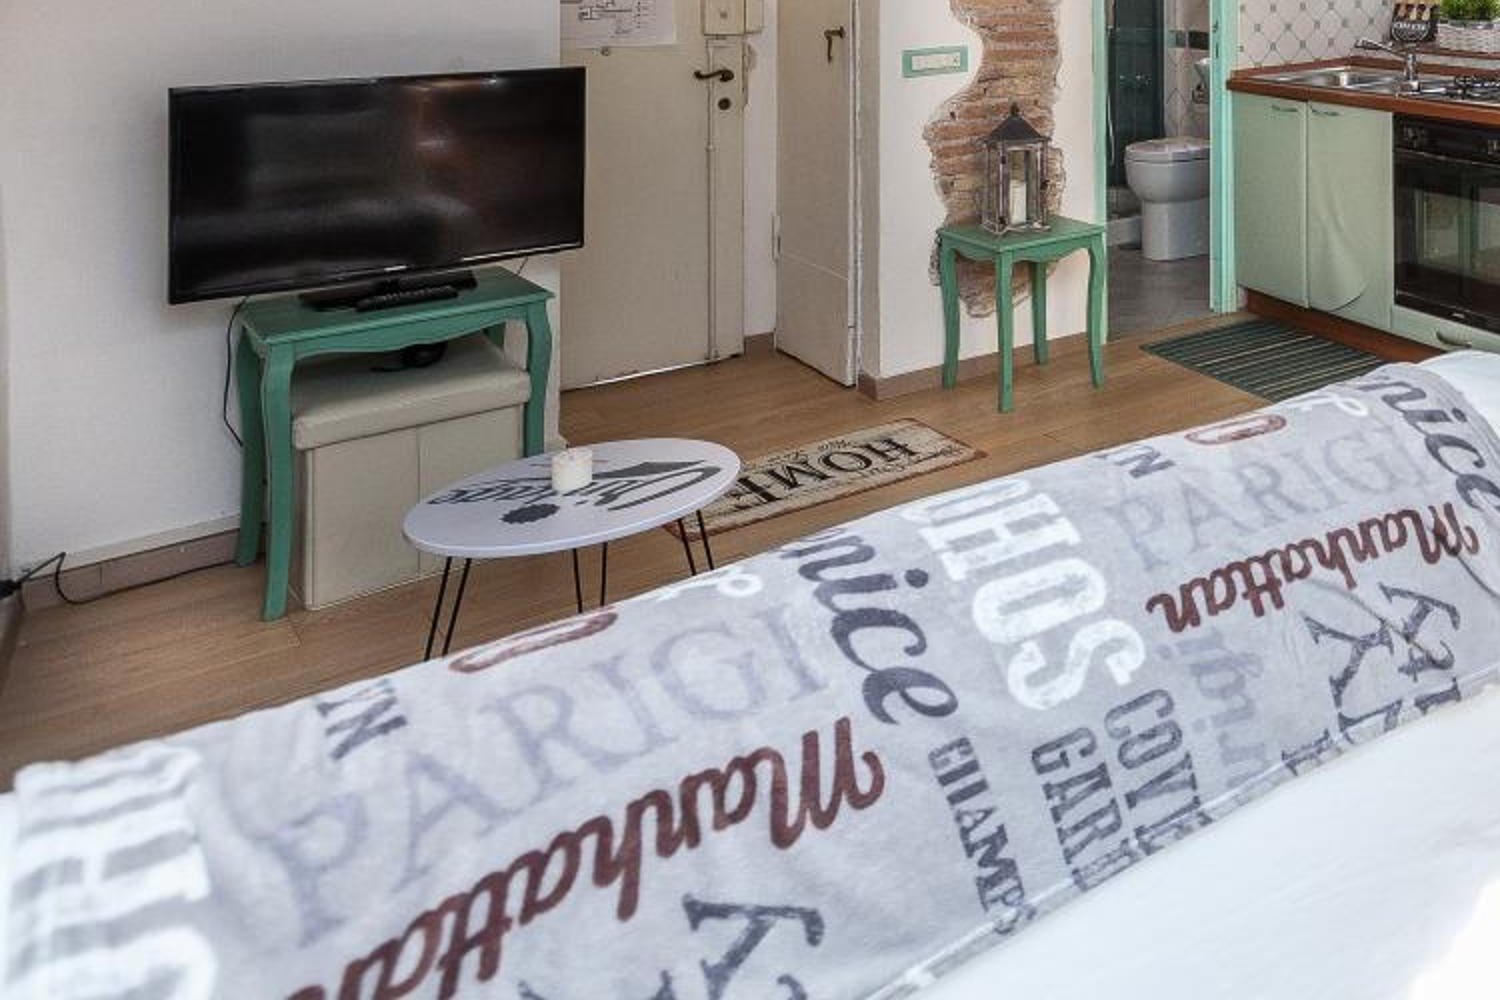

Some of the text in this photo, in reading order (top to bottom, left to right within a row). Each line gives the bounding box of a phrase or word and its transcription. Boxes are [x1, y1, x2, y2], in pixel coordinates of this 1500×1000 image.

[778, 533, 960, 726] nice
[1146, 502, 1479, 635] Manhattan
[285, 714, 886, 1000] Manhatta
